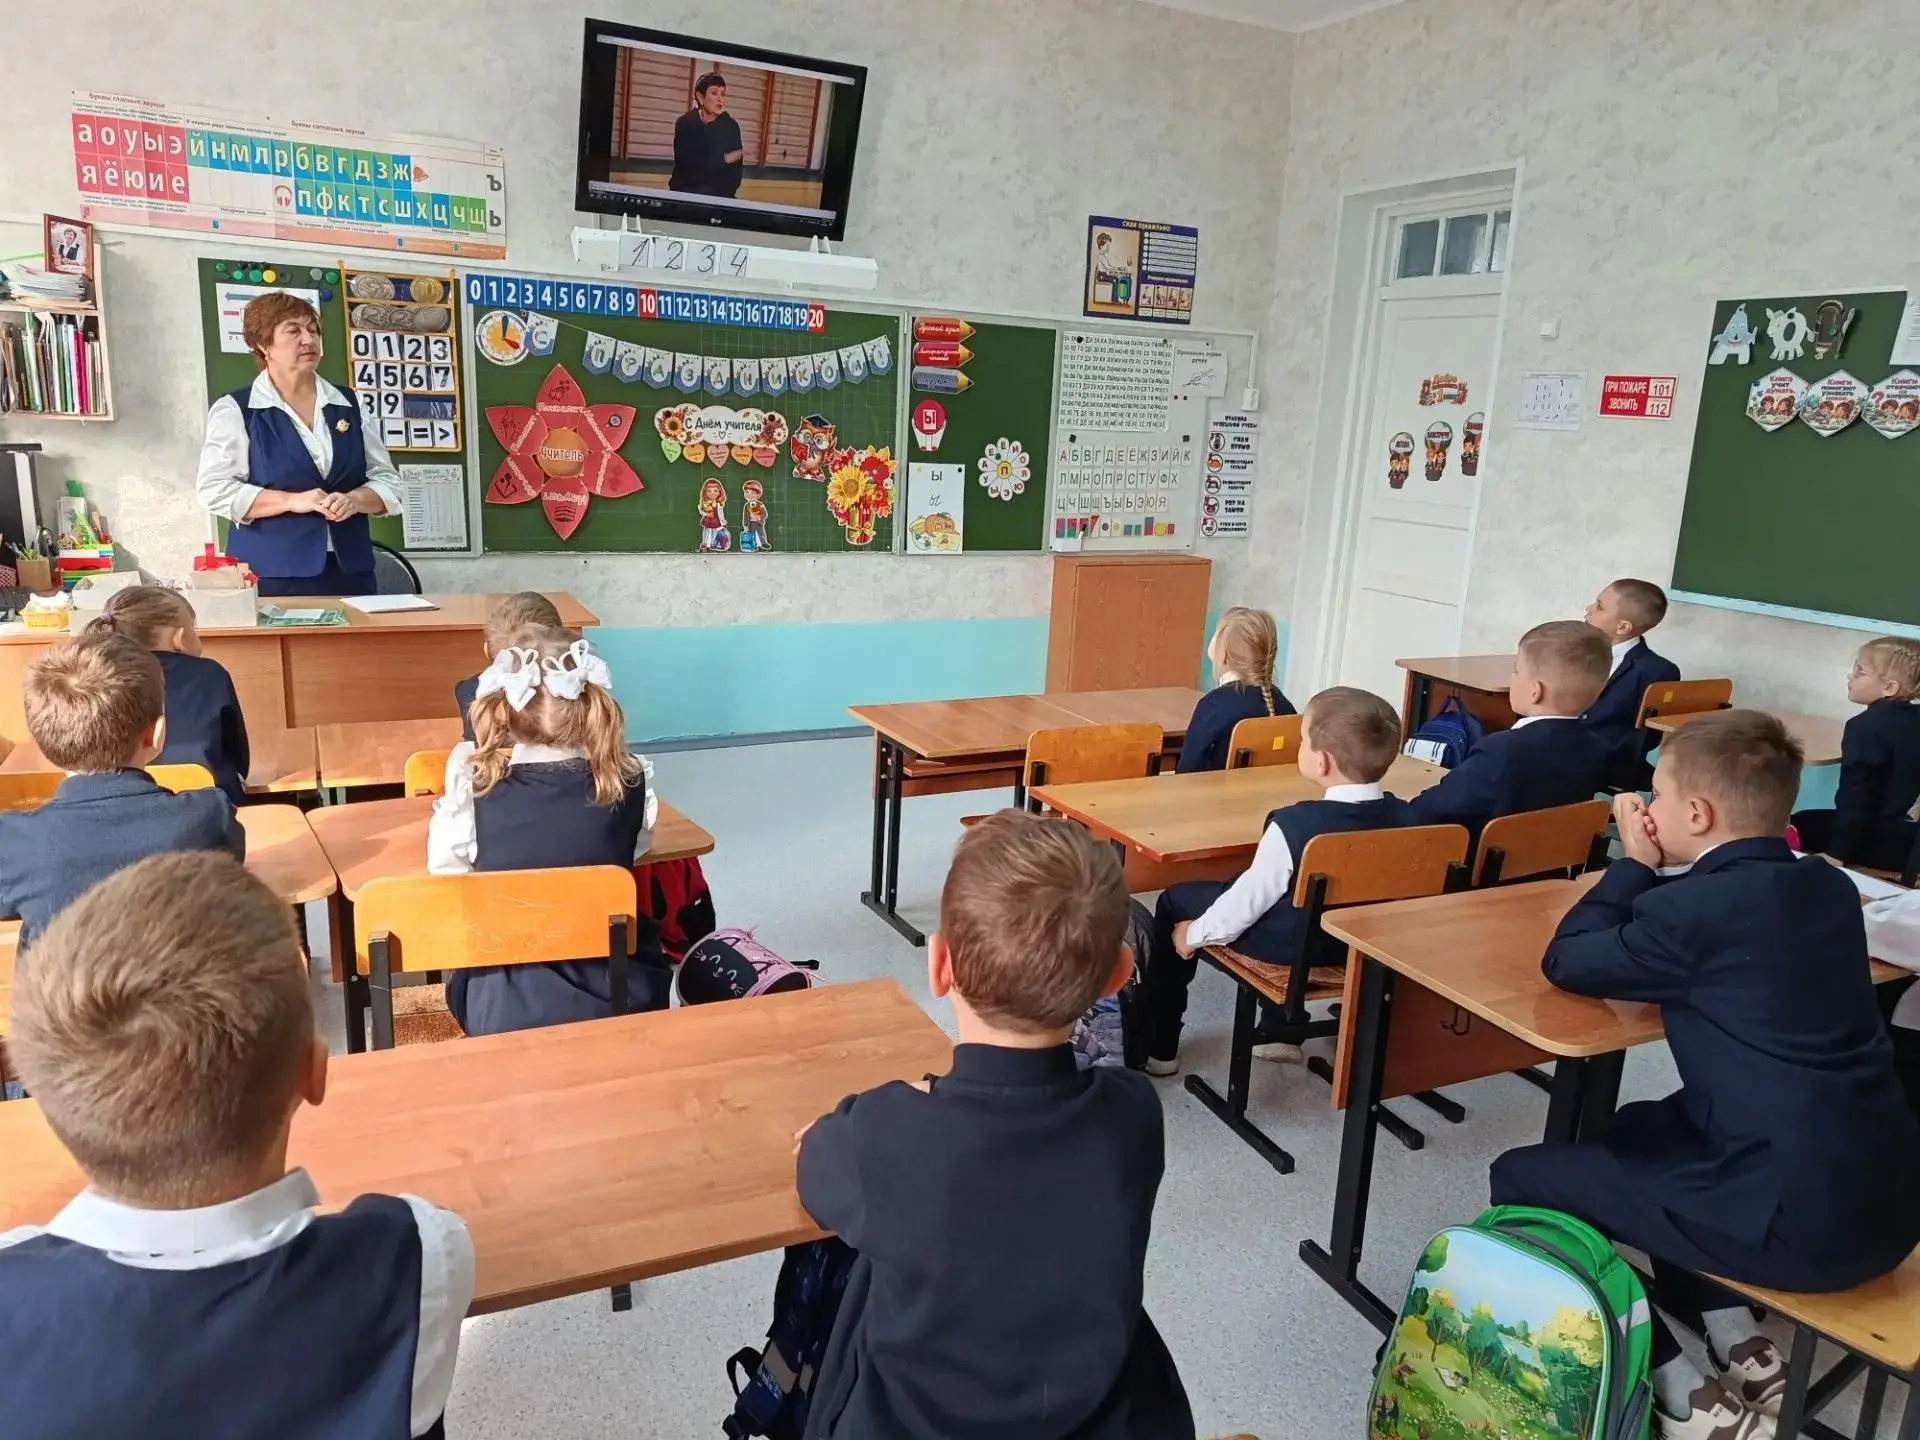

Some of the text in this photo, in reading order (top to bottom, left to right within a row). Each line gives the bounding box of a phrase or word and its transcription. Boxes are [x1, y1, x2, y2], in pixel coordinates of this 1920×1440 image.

[632, 237, 748, 276] 1 2 3 4
[470, 279, 824, 328] 0 1 2 3 4 5 6 7 8 9 10 11 12 13 14 15 16 17 18 19 20
[354, 334, 448, 361] 0 1 2 3
[357, 364, 450, 388] 4 5 6 7
[1605, 381, 1648, 394] ПРИ ПОЖАРЕ
[1653, 384, 1670, 396] 101
[384, 393, 399, 414] 9
[1608, 398, 1638, 411] ЗВОНИТЬ
[1650, 403, 1667, 415] 112
[686, 417, 762, 432] С Днём учителя
